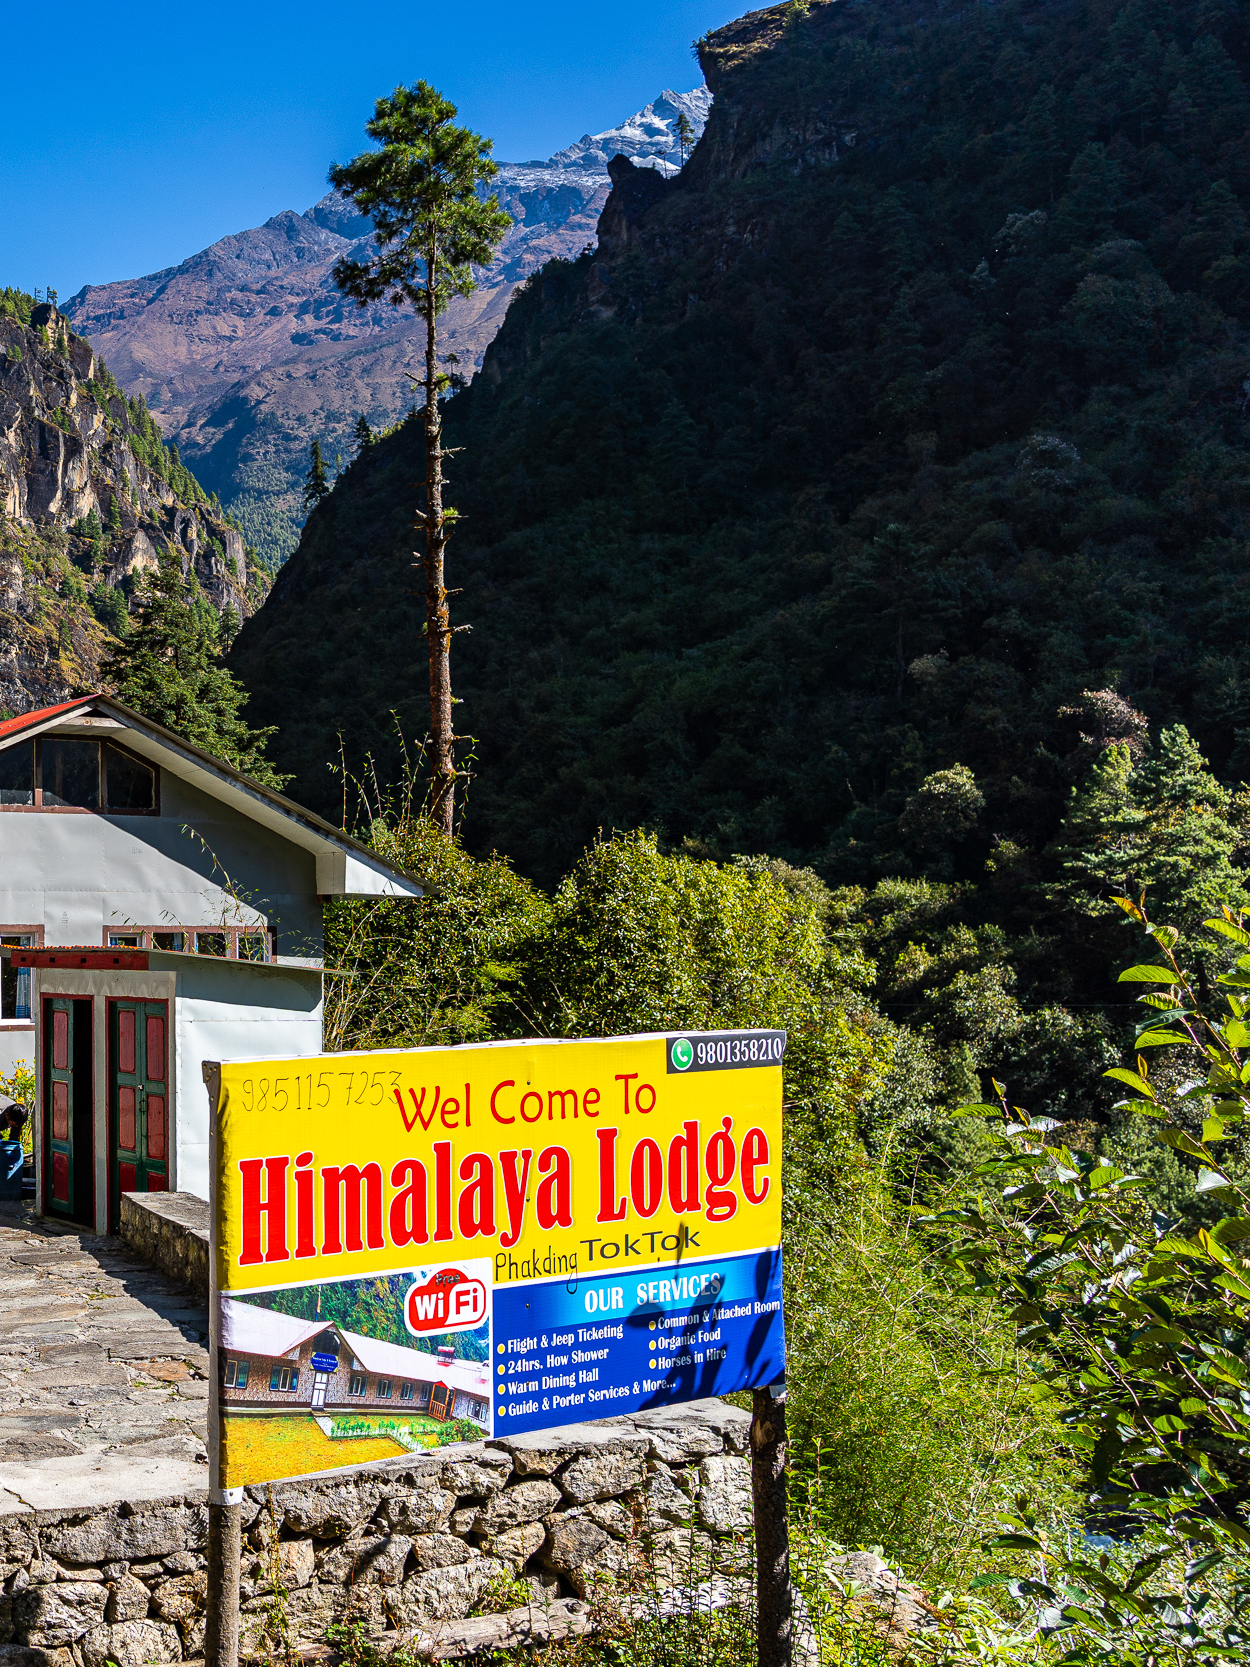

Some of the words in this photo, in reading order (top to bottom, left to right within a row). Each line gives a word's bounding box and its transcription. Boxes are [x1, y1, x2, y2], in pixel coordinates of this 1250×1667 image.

[697, 1038, 782, 1064] 9801358210
[393, 1083, 471, 1133] Wel
[490, 1079, 600, 1125] Come
[614, 1072, 657, 1115] To
[238, 1141, 574, 1267] Himalaya
[596, 1115, 771, 1223] Lodge
[584, 1286, 624, 1313] OUR
[636, 1273, 721, 1306] SERVICES
[657, 1314, 700, 1330] Common
[702, 1311, 710, 1323] &
[711, 1302, 752, 1321] Attached
[754, 1300, 781, 1315] Room
[507, 1336, 538, 1354] Flight
[540, 1336, 549, 1348] &
[550, 1332, 575, 1348] Jeep
[577, 1324, 624, 1342] Ticketing
[657, 1335, 696, 1352] Organic
[698, 1328, 721, 1344] Food
[507, 1358, 543, 1375] 24hrs.
[546, 1355, 570, 1368] How
[571, 1347, 609, 1364] Shower
[657, 1354, 692, 1371] Horses
[694, 1351, 704, 1364] in
[706, 1347, 727, 1362] Hire
[507, 1380, 539, 1396] Warm
[542, 1373, 576, 1391] Dining
[578, 1367, 599, 1383] Hall
[508, 1400, 539, 1417] Guide
[541, 1399, 550, 1412] &
[552, 1391, 586, 1408] Porter
[588, 1385, 630, 1403] Services
[632, 1381, 641, 1394] &
